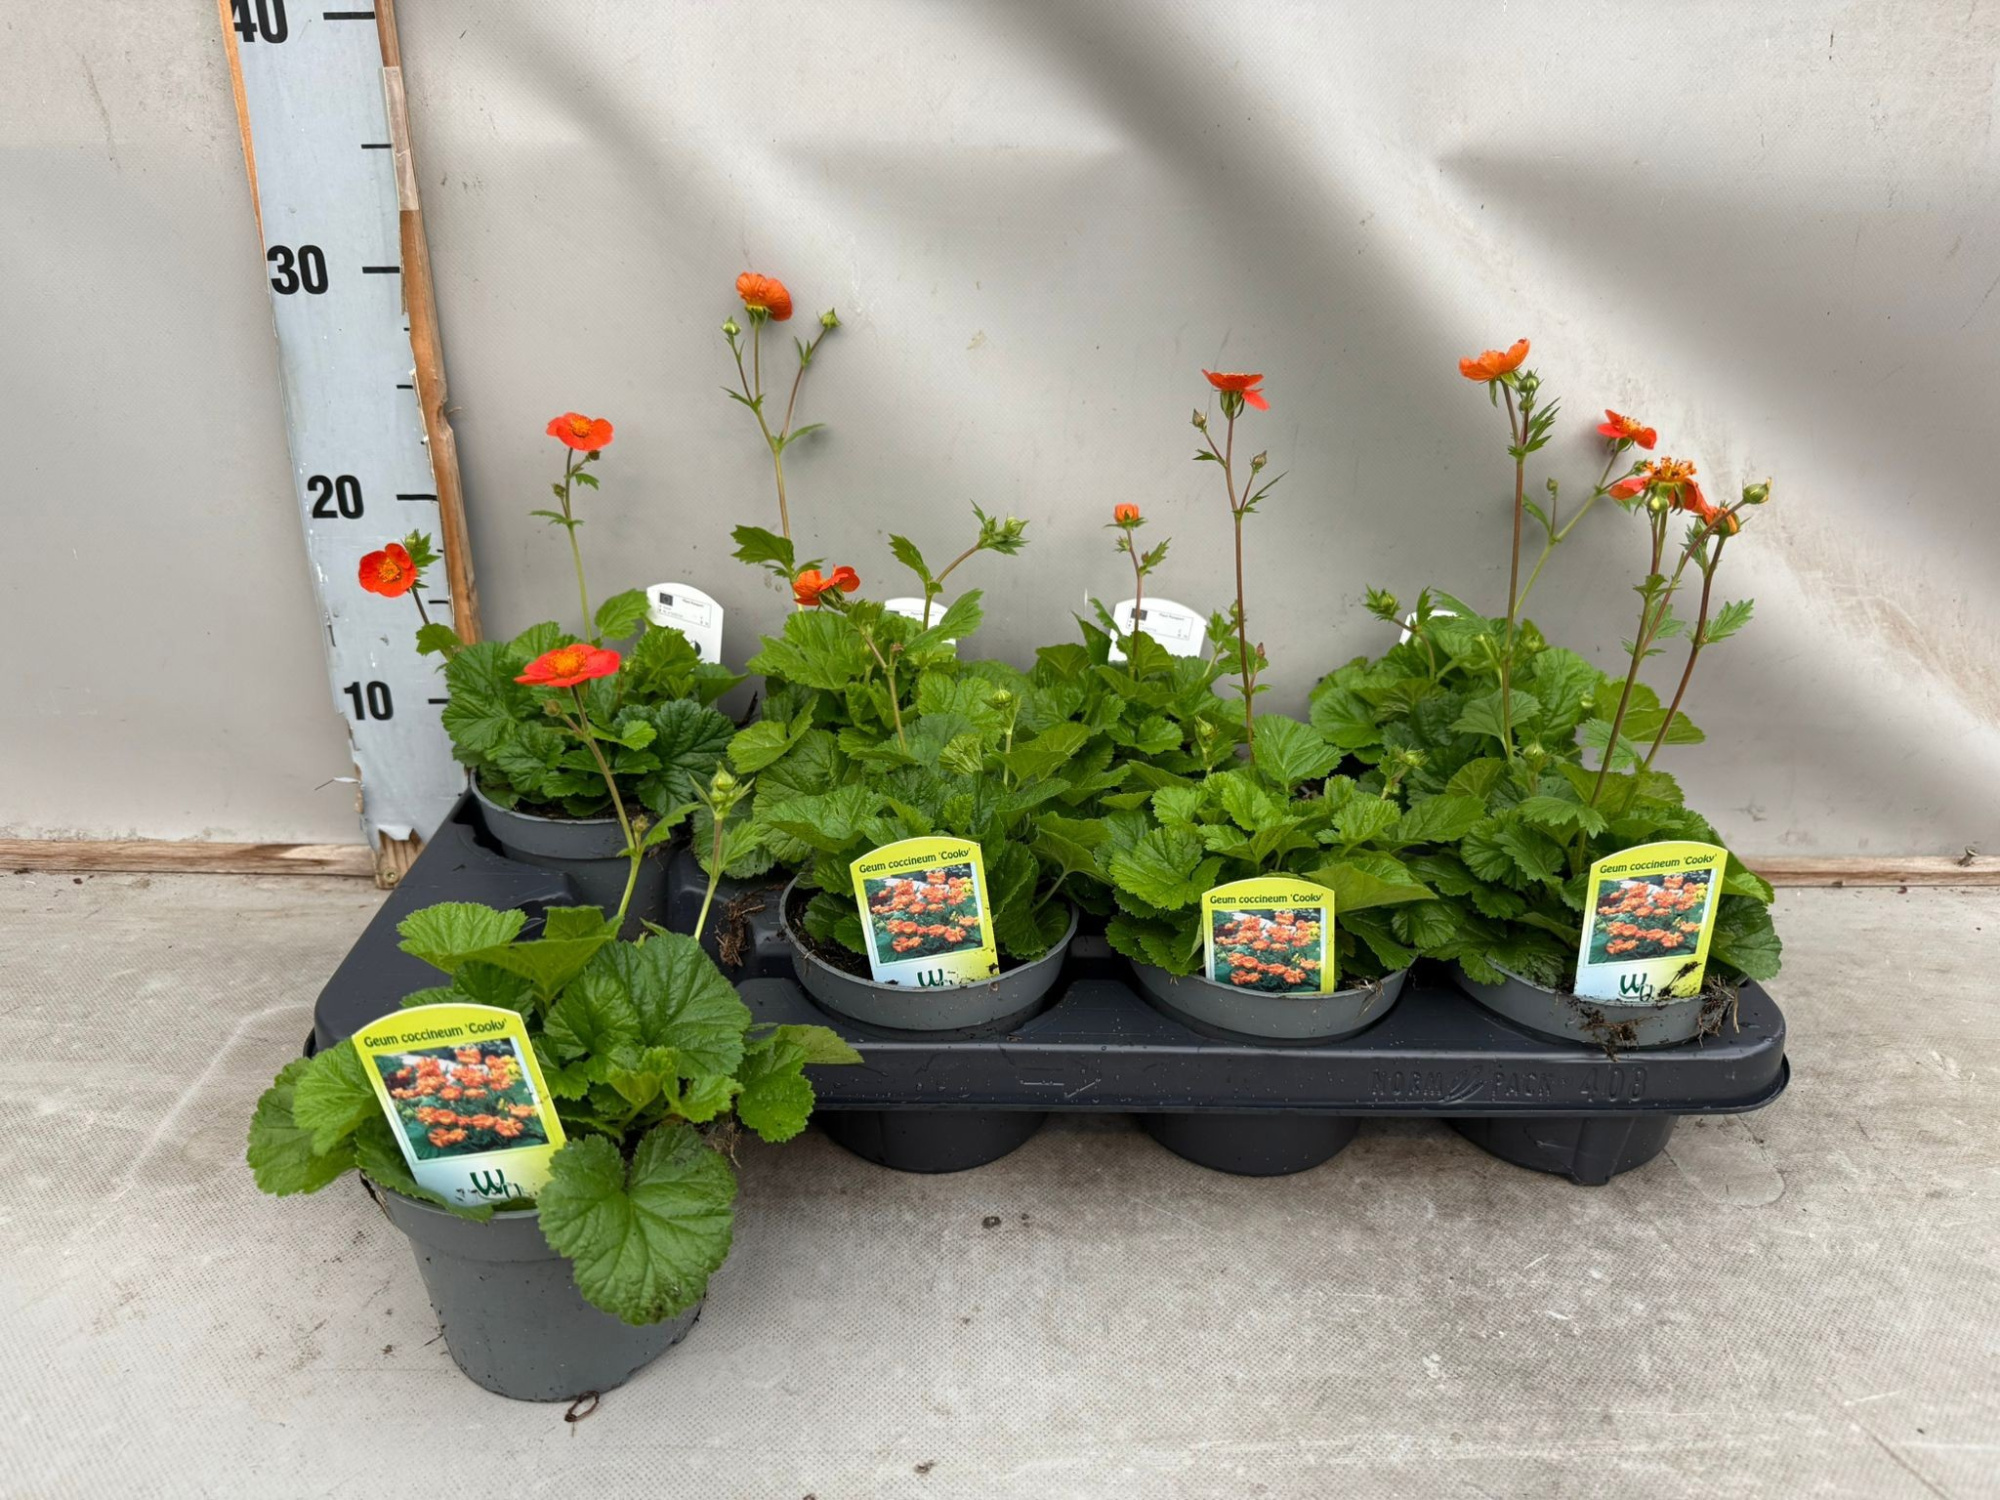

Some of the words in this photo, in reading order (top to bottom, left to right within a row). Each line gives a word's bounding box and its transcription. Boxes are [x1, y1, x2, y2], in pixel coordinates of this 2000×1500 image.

[231, 0, 288, 44] 40
[267, 245, 329, 295] 30
[307, 474, 364, 519] 20
[344, 680, 394, 721] 10
[859, 863, 887, 874] Geum
[888, 854, 937, 869] coccineum
[1600, 864, 1628, 874] Geum
[1629, 858, 1680, 871] coccineum
[1210, 895, 1237, 904] Geum
[1238, 894, 1288, 904] coccineum
[364, 1034, 399, 1049] Geum
[401, 1024, 464, 1044] coccineum
